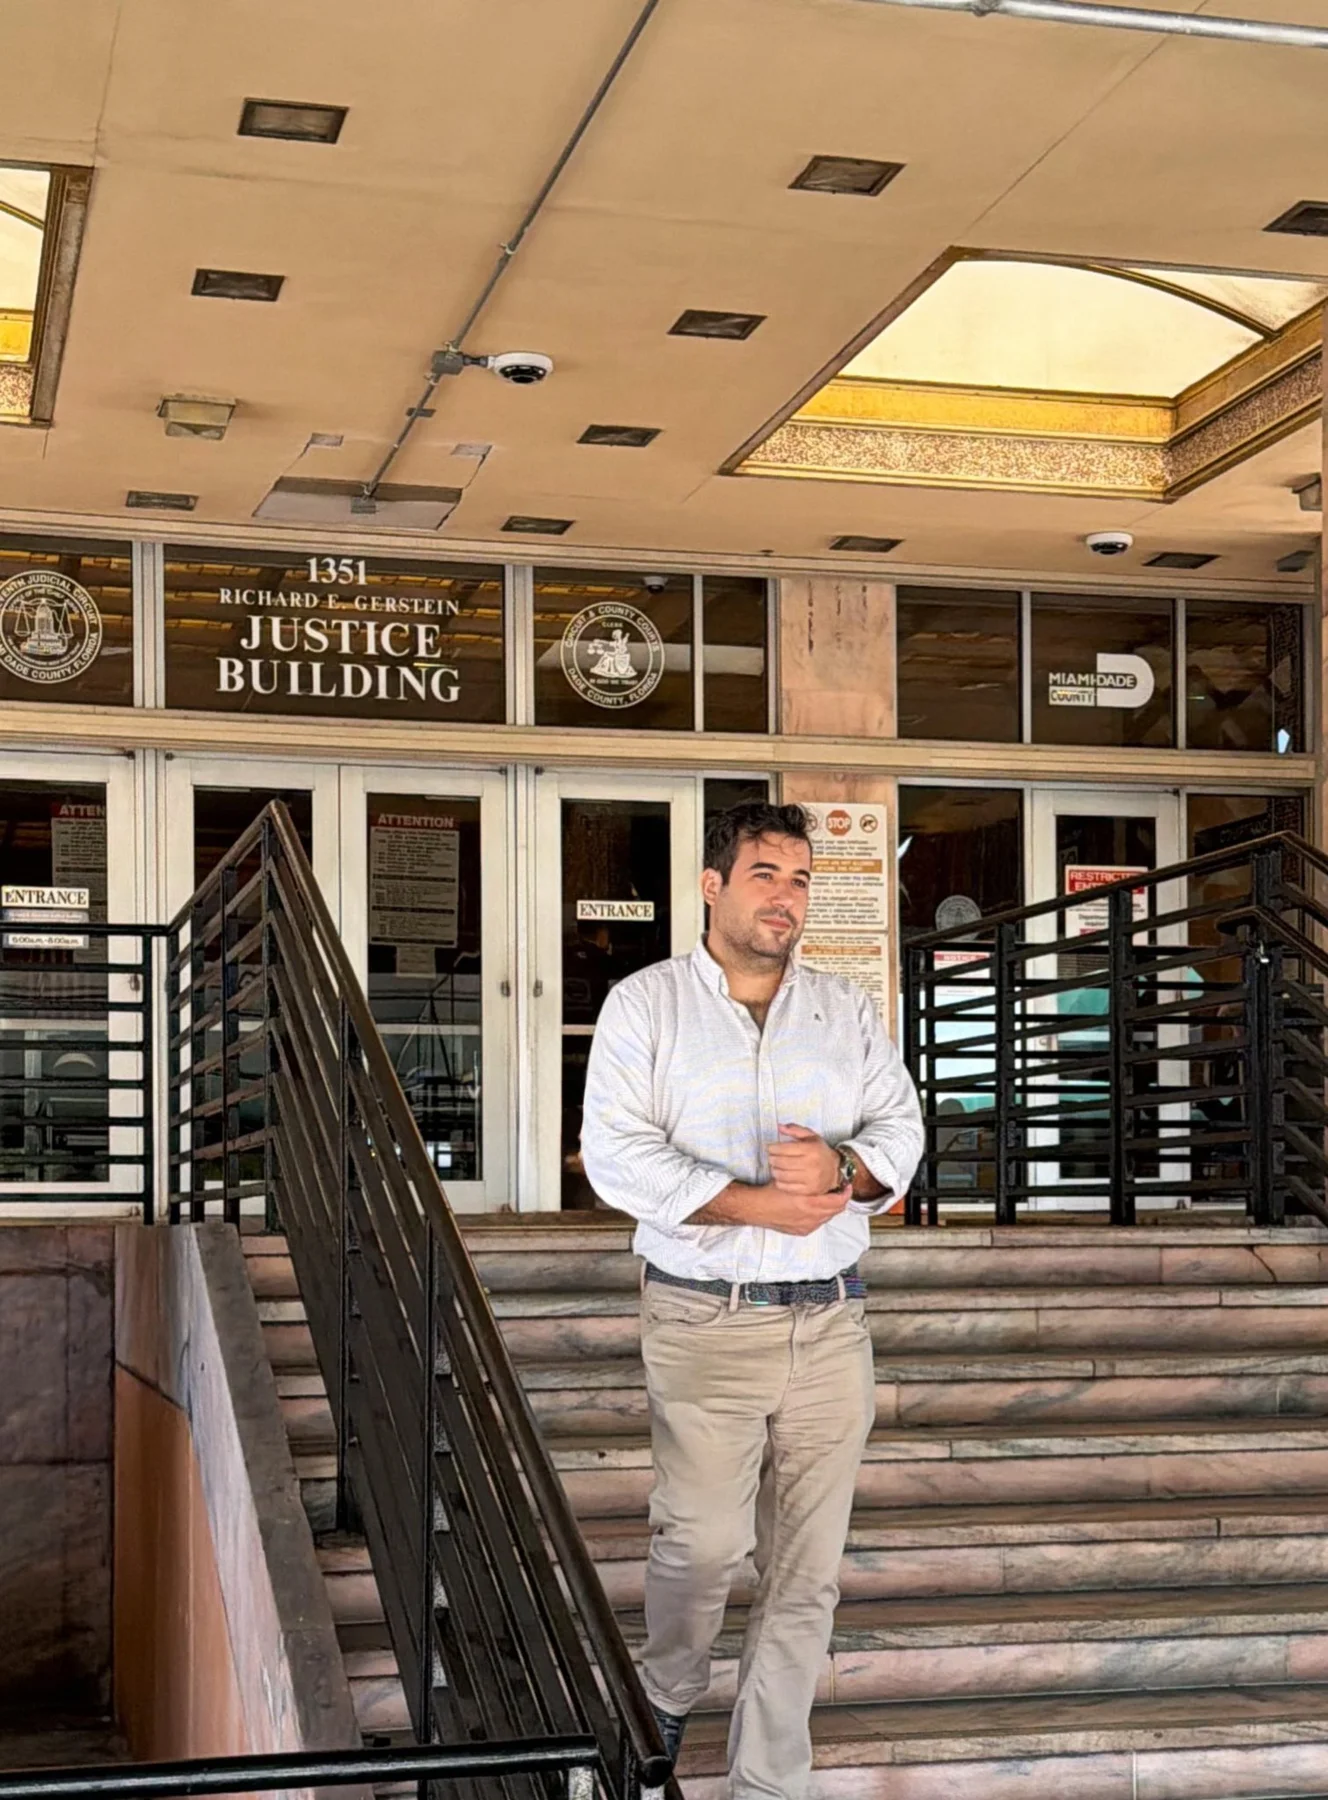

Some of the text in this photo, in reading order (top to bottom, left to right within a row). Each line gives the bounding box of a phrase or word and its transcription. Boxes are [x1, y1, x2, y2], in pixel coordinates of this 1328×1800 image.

[306, 557, 368, 585] 1351
[28, 574, 72, 593] JUDICIAL
[73, 587, 98, 625] CIRCUIT
[219, 588, 460, 616] RICHARD E. GERSTEIN
[240, 615, 442, 659] JUSTICE
[565, 605, 660, 653] CIRCUIT & COUNTY COURTS
[4, 654, 30, 676] DADE
[72, 632, 98, 670] FLORIDA
[216, 657, 461, 703] BUILDING
[568, 667, 587, 692] DADE
[629, 672, 657, 701] FLORIDA
[1050, 689, 1093, 702] COUNTY
[59, 803, 106, 817] ATTEN
[377, 813, 455, 828] ATTENTION
[828, 816, 851, 830] STOP
[1070, 871, 1140, 881] RESTRICT
[4, 889, 87, 905] ENTRANCE
[580, 903, 652, 917] ENTRANCE
